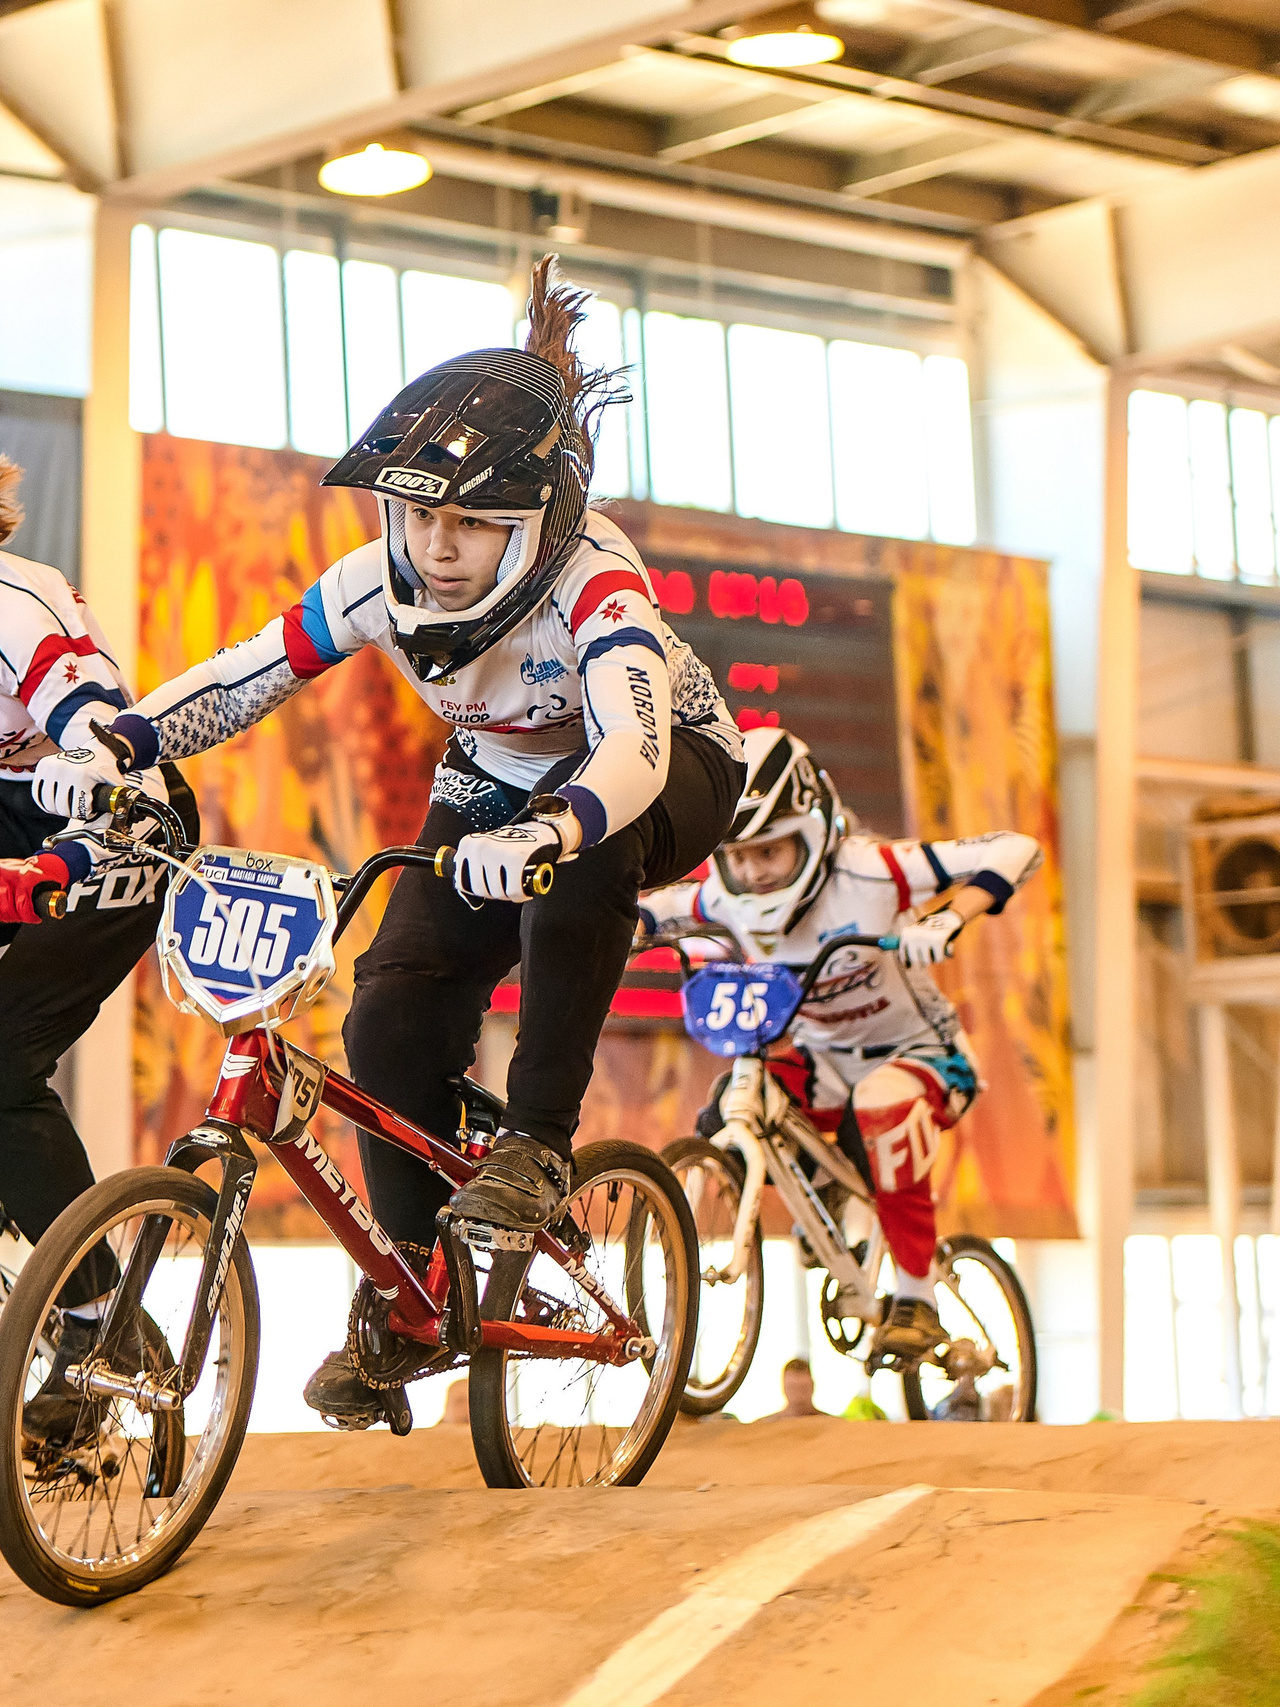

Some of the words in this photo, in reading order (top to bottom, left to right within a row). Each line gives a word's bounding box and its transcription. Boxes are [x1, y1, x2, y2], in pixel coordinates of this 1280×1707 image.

[385, 472, 439, 492] 100%
[459, 466, 493, 496] AIRCRAFT
[440, 700, 462, 711] ГБУ
[465, 701, 487, 712] РМ
[442, 711, 490, 723] СШОР
[246, 852, 274, 871] box
[205, 869, 226, 881] UCI
[66, 864, 168, 912] FOX
[188, 893, 297, 978] 505
[706, 982, 768, 1031] 55
[294, 1127, 393, 1257] MEYBO
